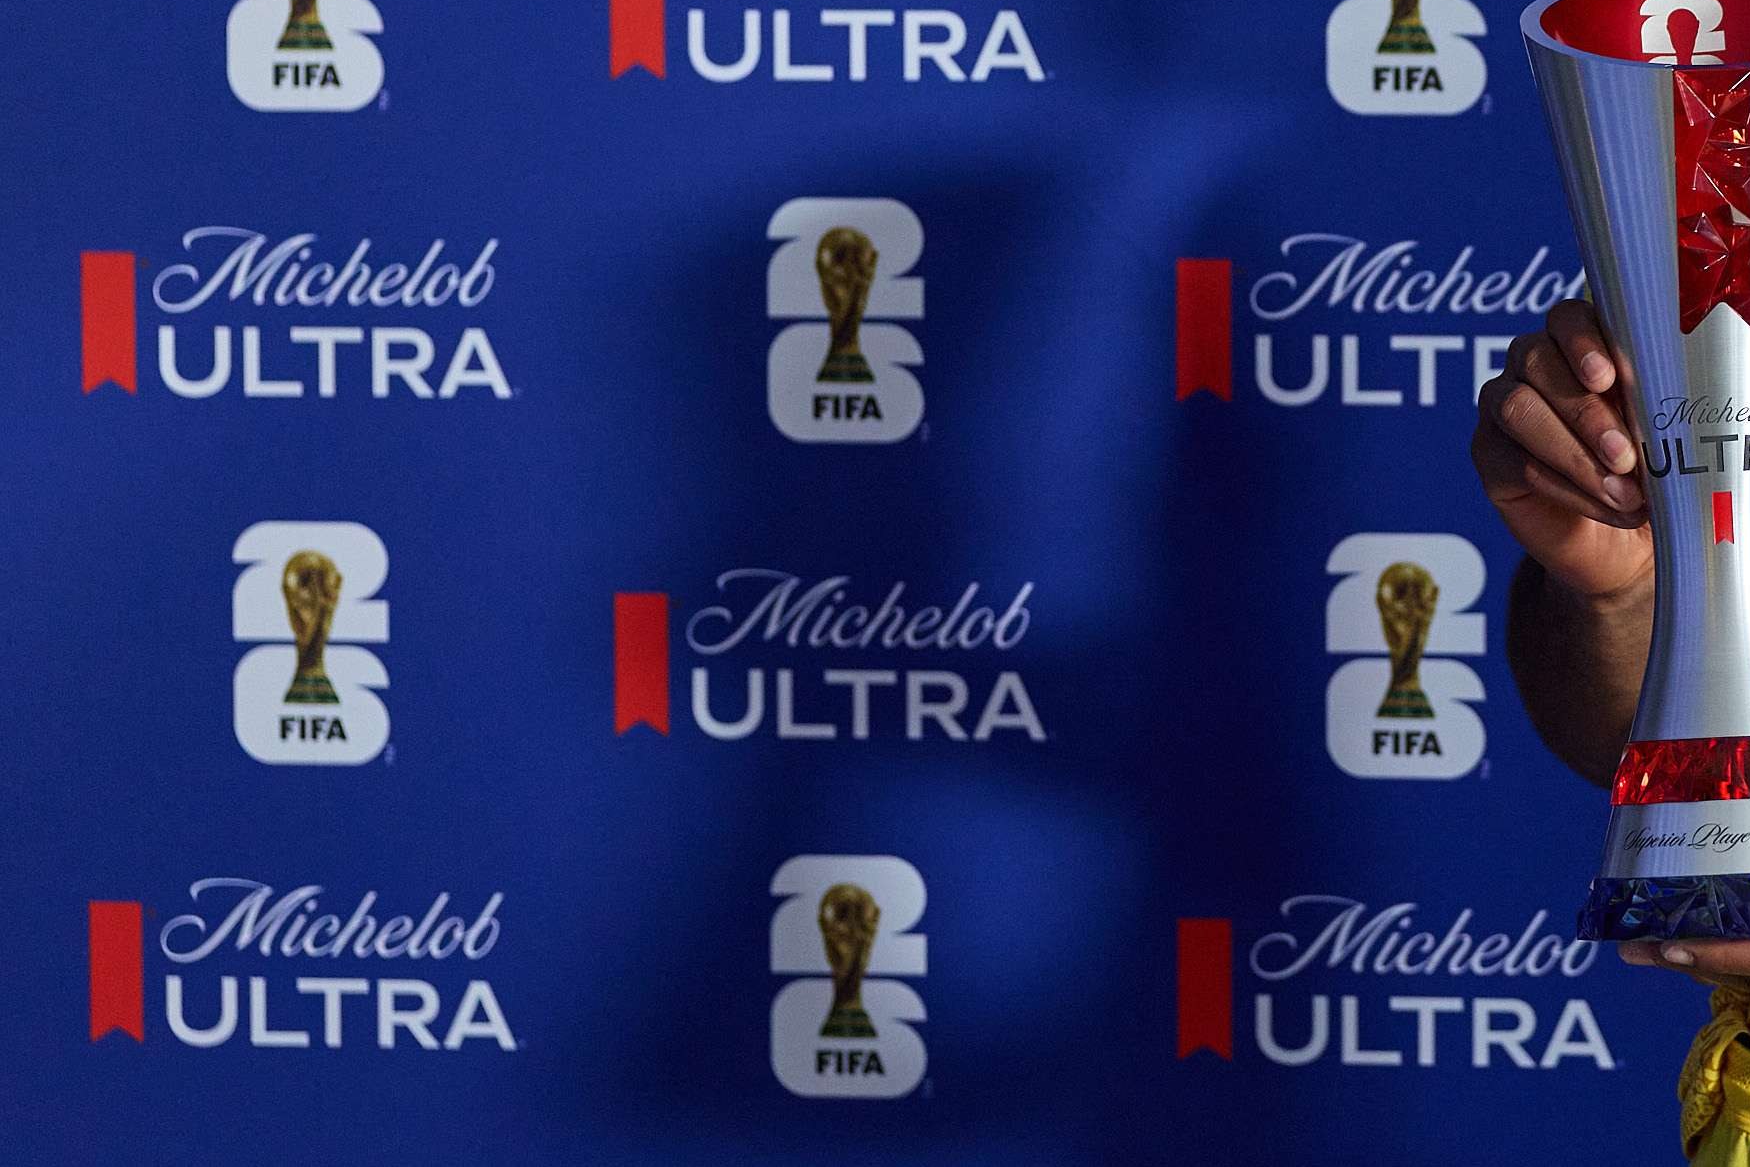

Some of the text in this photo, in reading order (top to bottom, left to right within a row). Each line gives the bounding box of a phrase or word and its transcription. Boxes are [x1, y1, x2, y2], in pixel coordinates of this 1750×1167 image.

[273, 63, 340, 87] FIFA
[688, 10, 1044, 82] ULTRA
[1373, 67, 1443, 91] FIFA
[153, 227, 498, 313] Michelob
[159, 326, 511, 398] ULTRA
[1255, 334, 1516, 406] ULT
[813, 395, 882, 421] FIFA
[686, 569, 1035, 654] Michelob
[280, 717, 347, 741] FIFA
[692, 668, 1045, 740] ULTRA
[1372, 730, 1442, 756] FIFA
[1624, 826, 1687, 857] Superior
[161, 878, 503, 963] Michelob
[166, 976, 516, 1050] ULTRA
[1255, 995, 1615, 1069] ULTRA
[816, 1050, 885, 1075] FIFA
